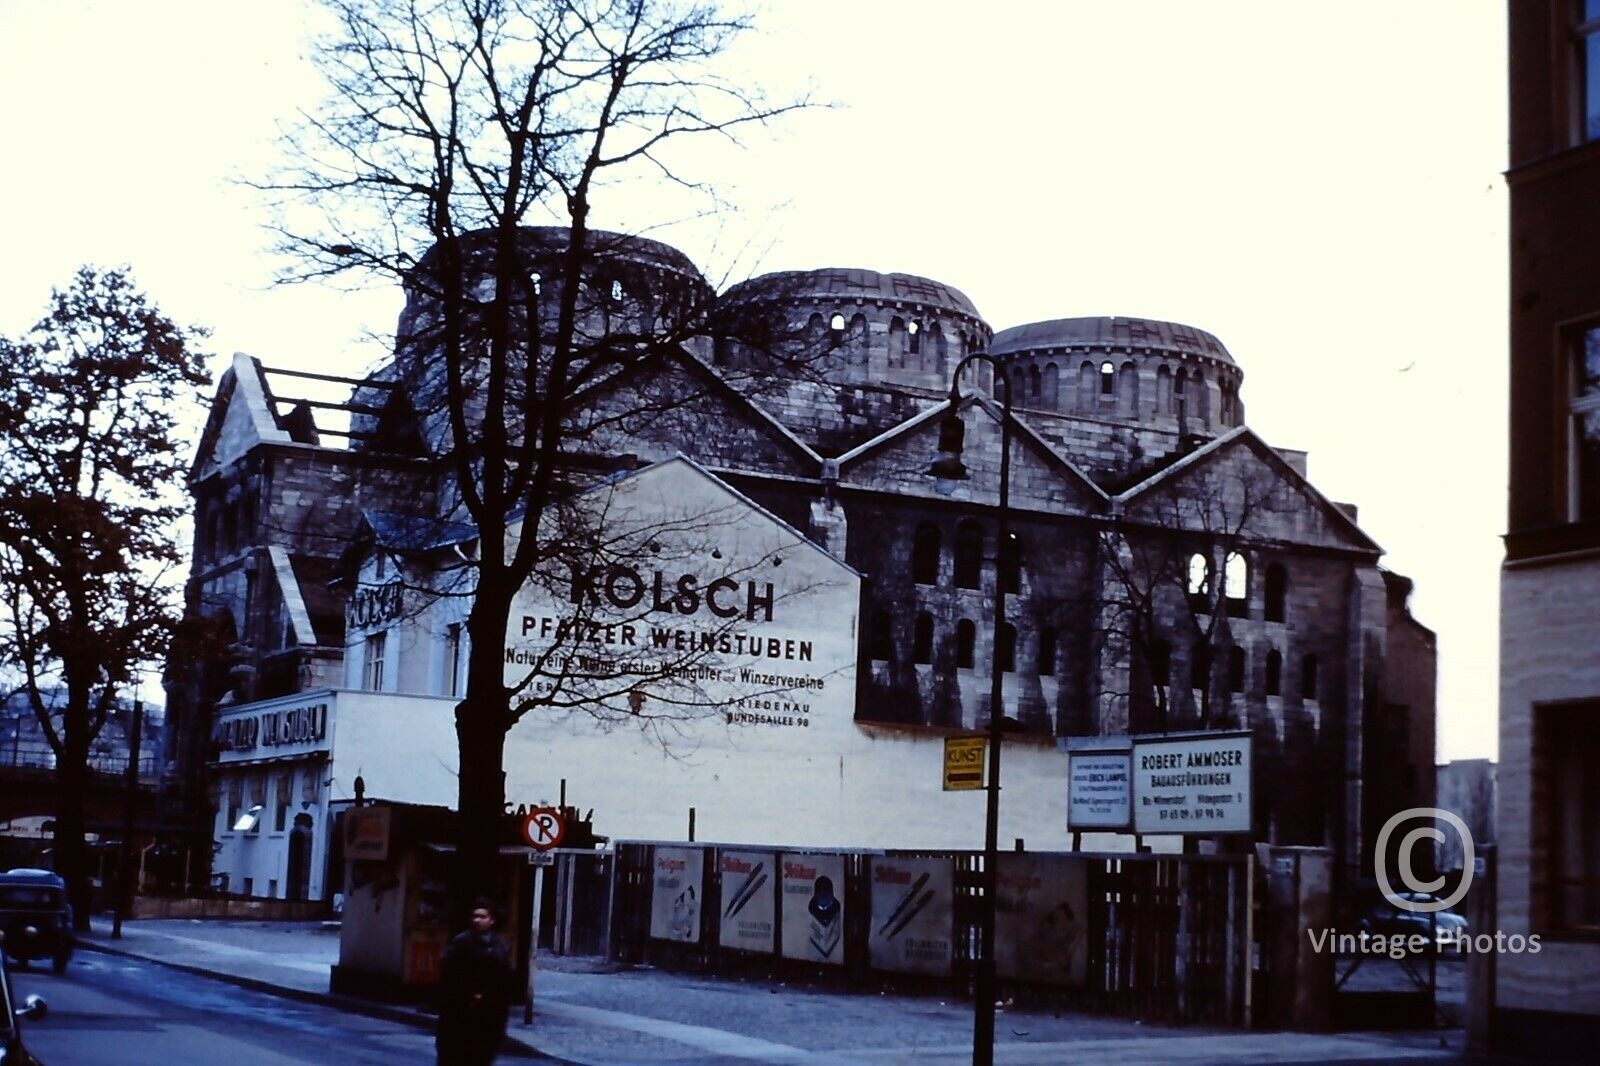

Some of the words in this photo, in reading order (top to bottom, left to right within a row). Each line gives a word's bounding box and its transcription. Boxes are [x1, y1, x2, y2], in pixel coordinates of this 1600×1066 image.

[652, 627, 813, 662] WEINSTUBEN
[739, 667, 825, 690] Winzervereine
[726, 712, 794, 726] BUNDESALLEE
[795, 717, 810, 728] 98
[1141, 753, 1183, 771] ROBERT
[1186, 749, 1243, 769] AMMOSER
[1151, 770, 1232, 788] BAUAUSFÜHRUNGEN
